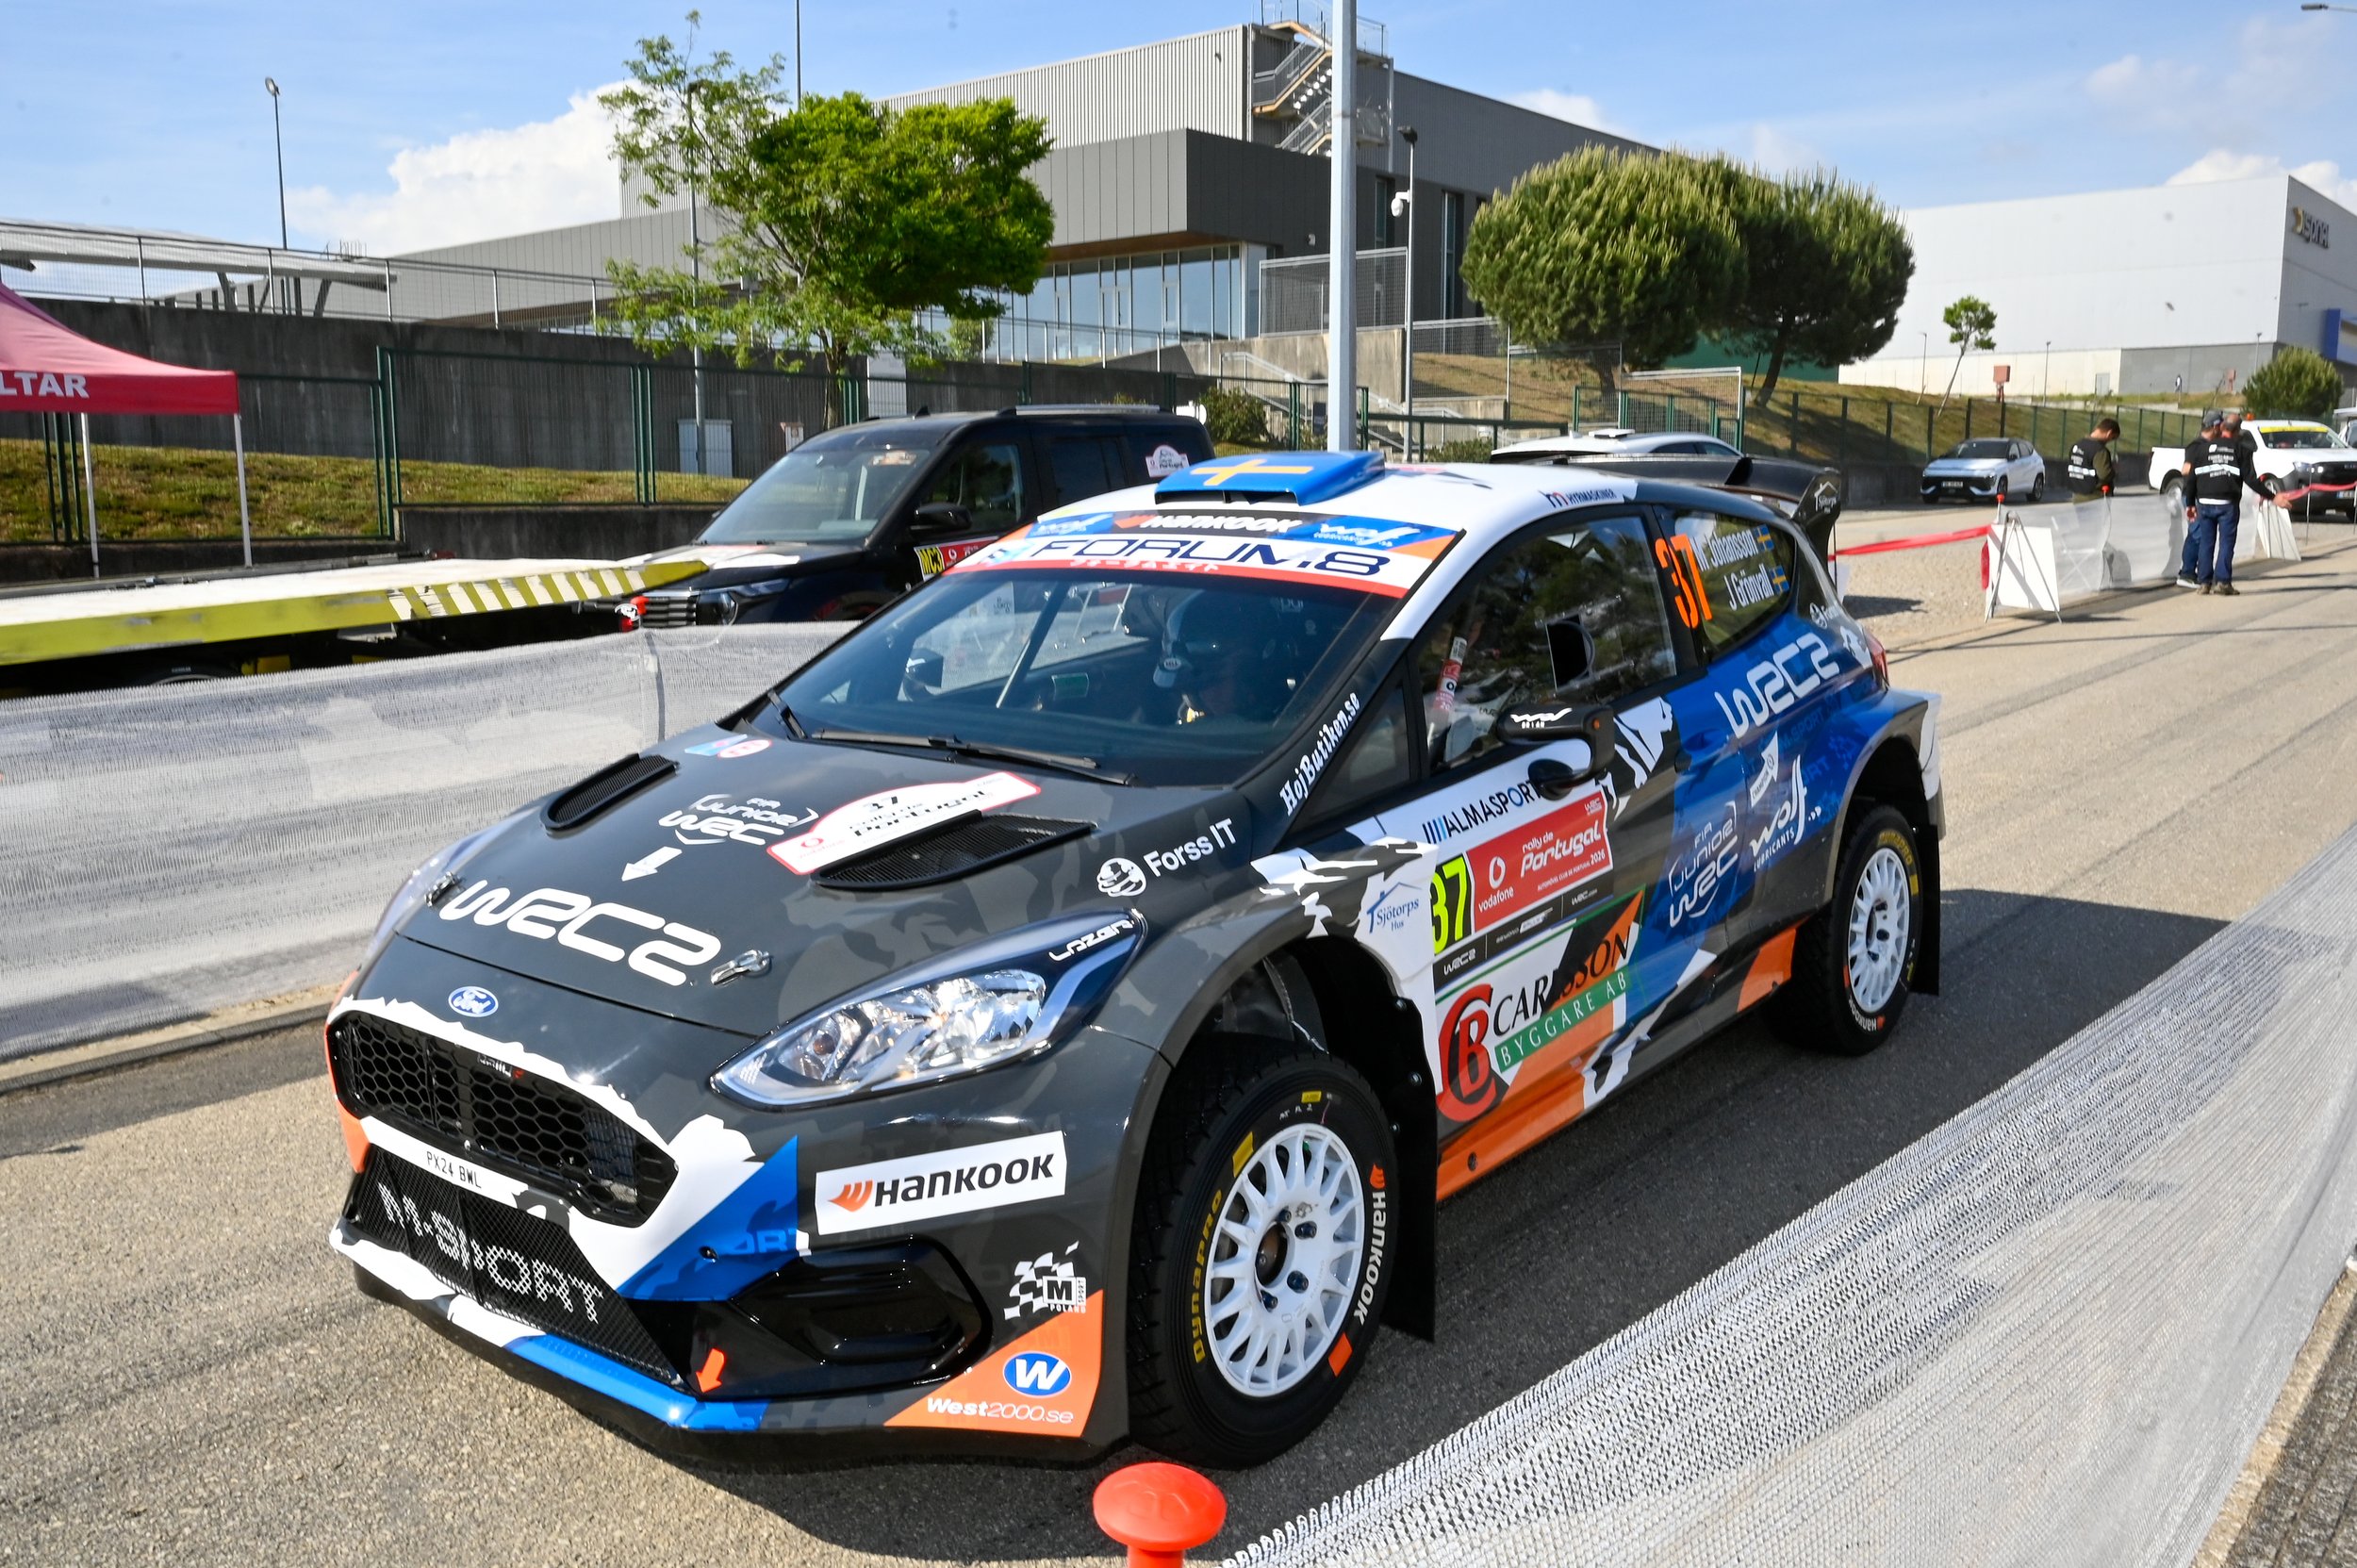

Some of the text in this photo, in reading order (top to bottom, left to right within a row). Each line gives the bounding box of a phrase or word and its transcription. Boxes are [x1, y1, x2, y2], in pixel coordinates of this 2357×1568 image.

[1030, 538, 1391, 576] FORUM8
[1689, 528, 1759, 572] M Johansson
[1655, 533, 1713, 629] 37
[1723, 564, 1775, 611] J Grönvall
[1714, 632, 1839, 739] WRC2
[1143, 817, 1237, 877] Forss IT
[1520, 820, 1602, 878] Portugal
[1590, 849, 1606, 867] 2026
[1674, 818, 1734, 892] JUNIOR
[1694, 822, 1712, 849] FIA
[1754, 827, 1795, 873] LUBRICANTS
[1477, 886, 1514, 913] vodafone
[1670, 834, 1739, 928] WRC
[1376, 899, 1419, 928] Sjötorps
[1429, 856, 1468, 955] 37
[439, 880, 722, 986] WRC2
[1443, 949, 1475, 976] WRC2
[1500, 991, 1596, 1067] BYGGARE
[427, 1150, 482, 1189] PX24 BWL
[378, 1181, 604, 1325] M-SPORT
[1047, 1279, 1072, 1301] M
[1049, 1304, 1086, 1314] POLAND
[1015, 1359, 1067, 1391] W
[927, 1397, 1074, 1424] West2000.se
